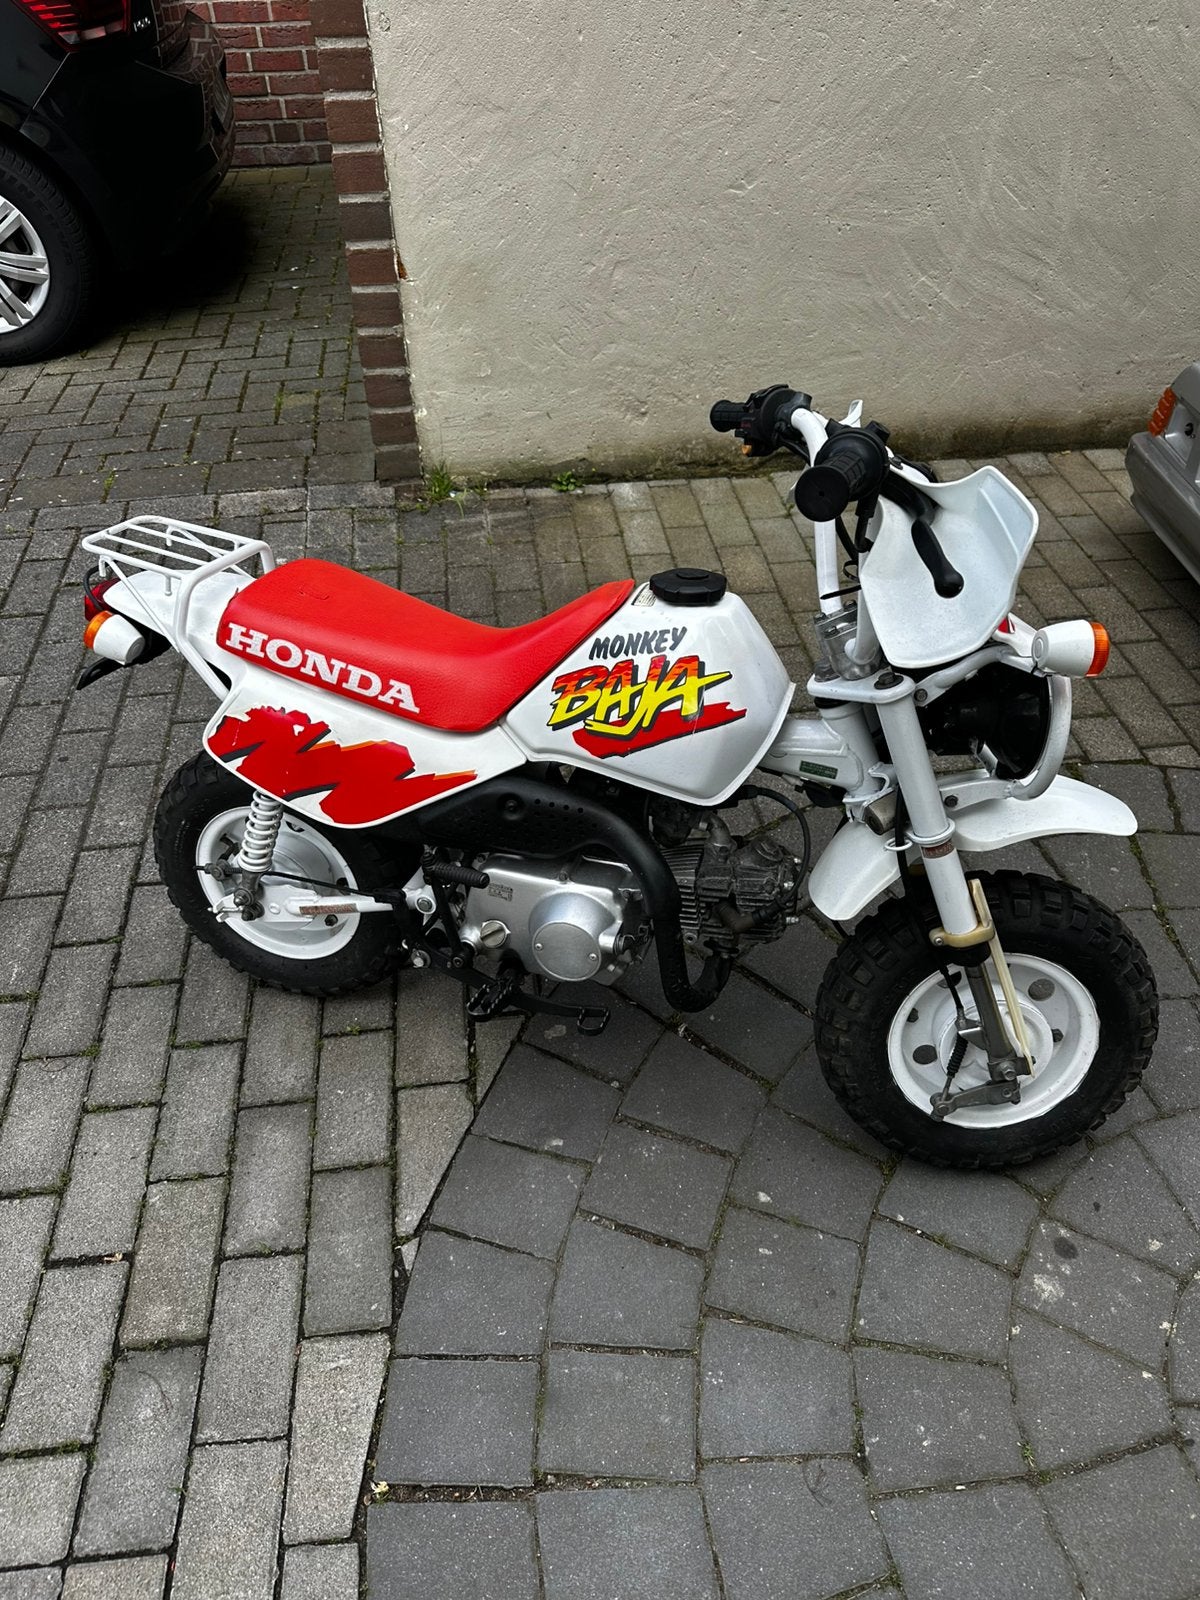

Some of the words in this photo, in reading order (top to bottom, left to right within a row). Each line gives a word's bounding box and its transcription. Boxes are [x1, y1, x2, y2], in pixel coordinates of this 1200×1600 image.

[226, 622, 420, 714] HONDA
[588, 626, 687, 660] MONKEY
[547, 655, 733, 740] BAJA
